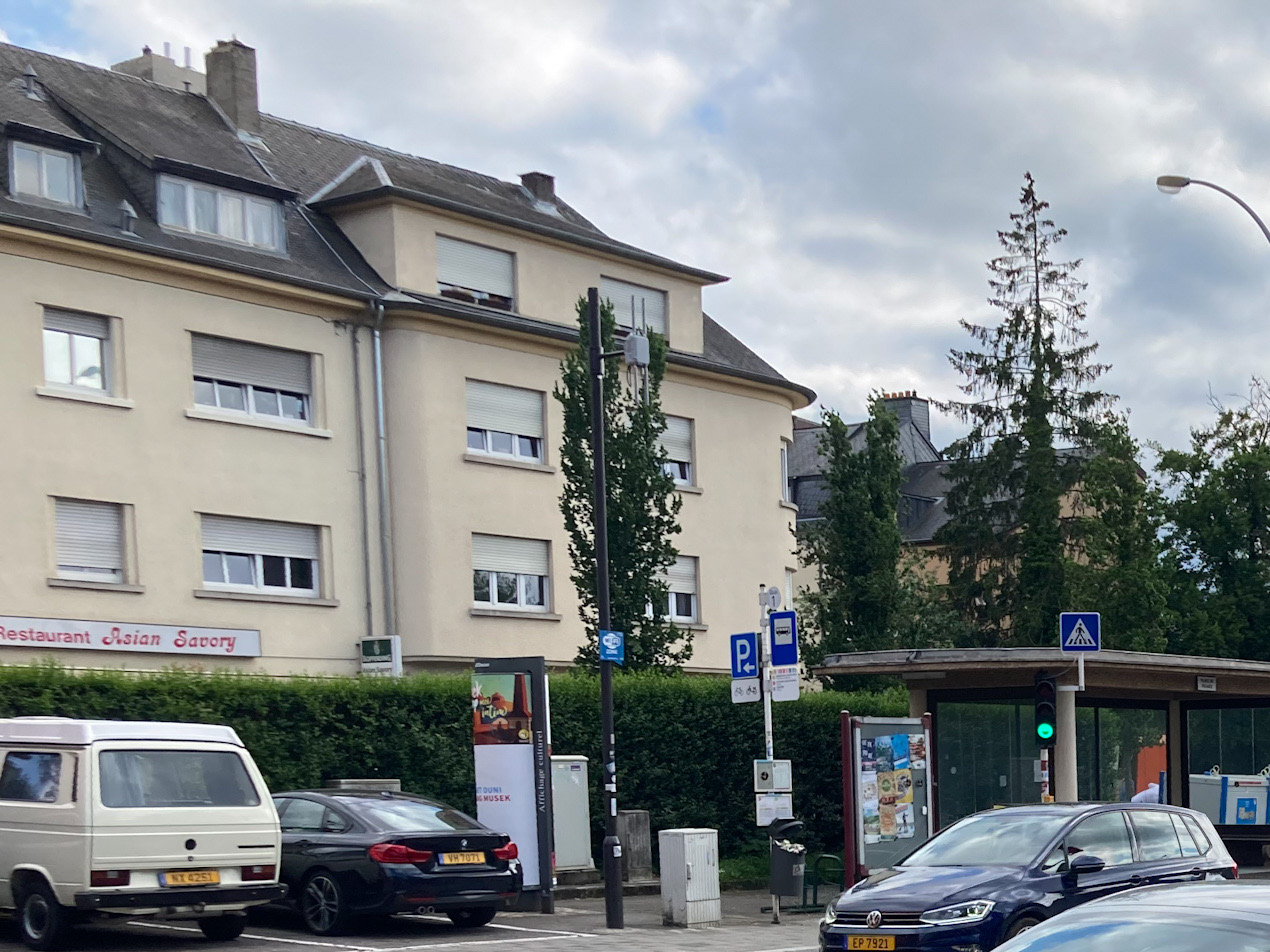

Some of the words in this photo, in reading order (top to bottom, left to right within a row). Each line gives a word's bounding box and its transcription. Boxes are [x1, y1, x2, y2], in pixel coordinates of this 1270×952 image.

[0, 625, 91, 644] Restaurant
[102, 627, 161, 646] Asian
[174, 629, 236, 652] Savory
[736, 639, 751, 673] P
[538, 768, 546, 813] Affichage
[447, 853, 459, 863] VH
[852, 937, 865, 949] EP
[866, 938, 889, 949] 7921
